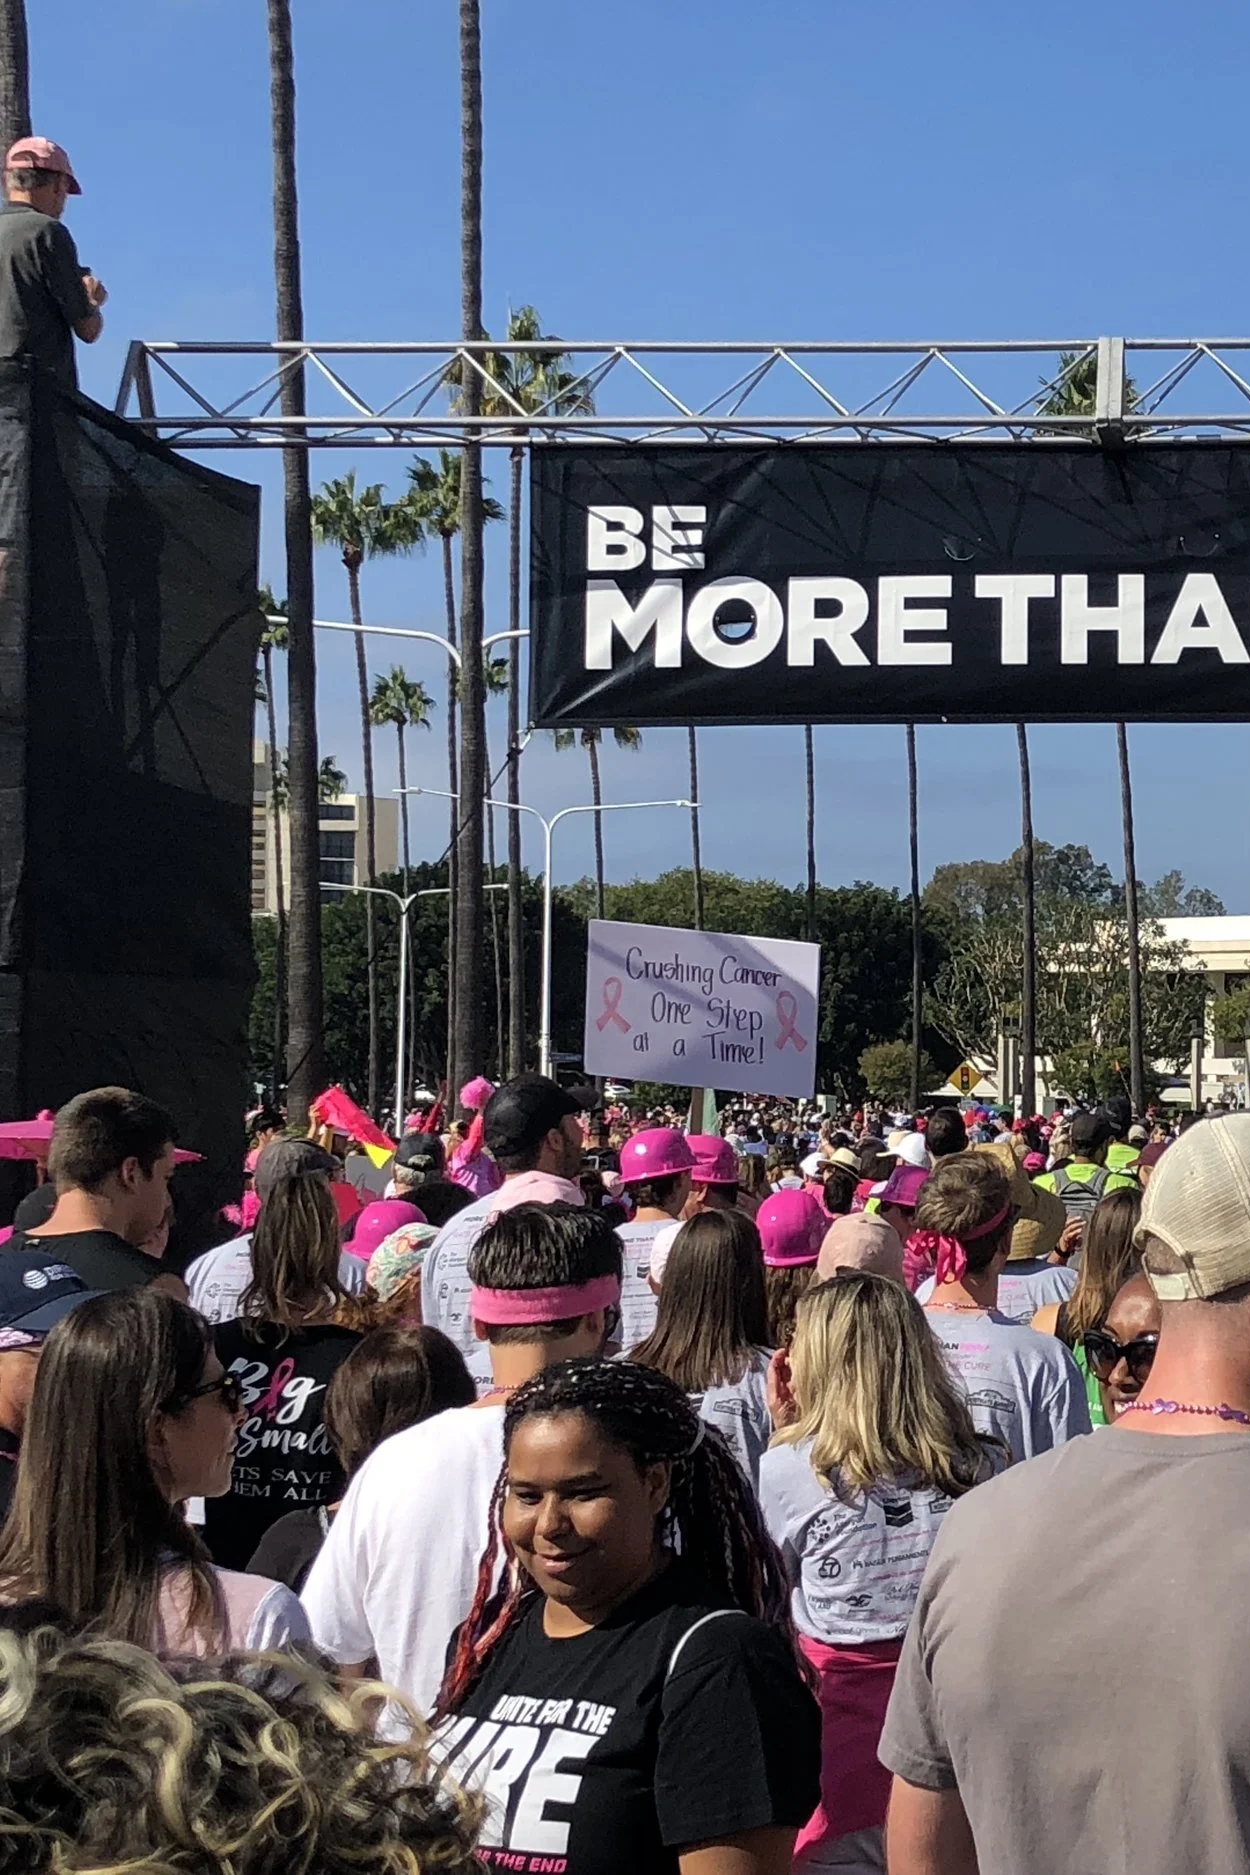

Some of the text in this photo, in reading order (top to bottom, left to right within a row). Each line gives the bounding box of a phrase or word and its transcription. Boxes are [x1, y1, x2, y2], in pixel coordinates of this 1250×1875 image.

[587, 505, 706, 571] BE
[585, 574, 952, 670] MORE
[625, 946, 782, 996] Crushing Cancer
[651, 991, 763, 1040] One Step
[633, 1031, 764, 1064] at a Time!
[232, 1466, 332, 1485] TS SAVE
[234, 1481, 328, 1501] EM ALL
[489, 1694, 617, 1736] UNITE FOR THE
[426, 1713, 602, 1855] URE
[495, 1851, 527, 1872] THE
[528, 1857, 568, 1873] END
